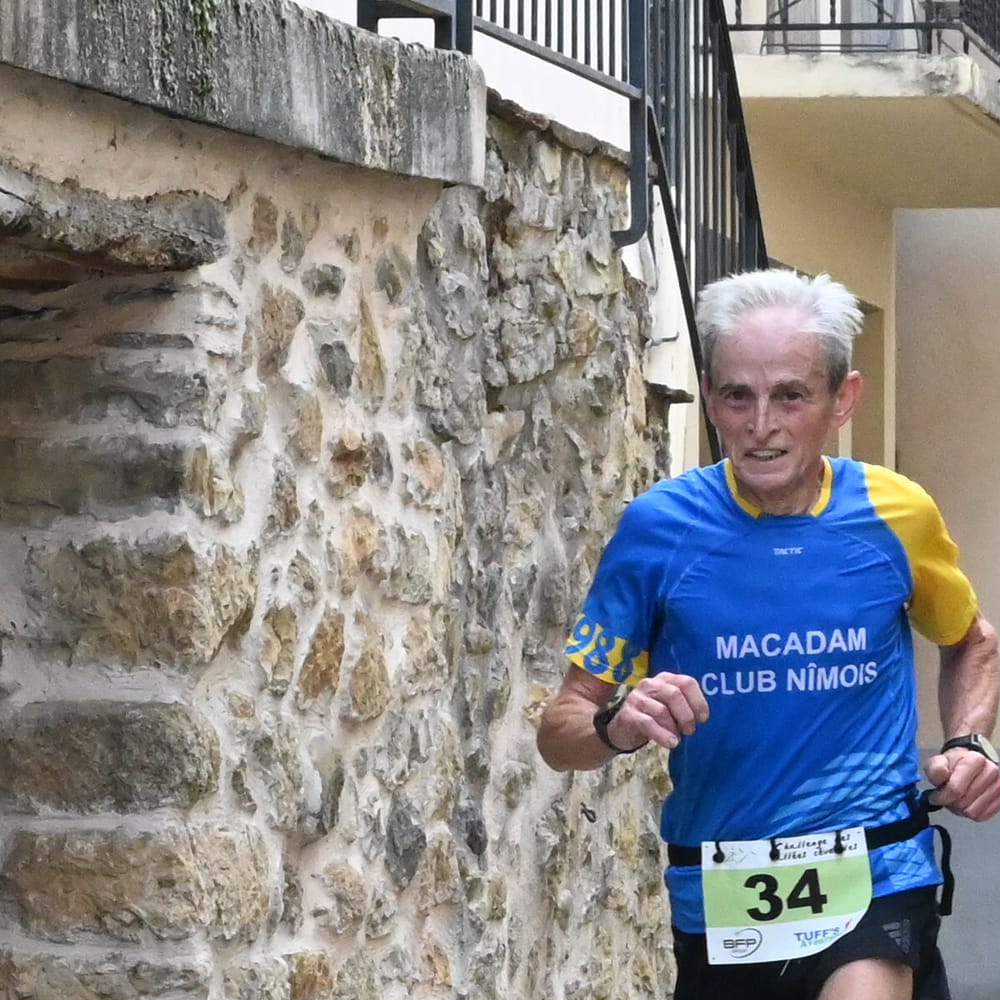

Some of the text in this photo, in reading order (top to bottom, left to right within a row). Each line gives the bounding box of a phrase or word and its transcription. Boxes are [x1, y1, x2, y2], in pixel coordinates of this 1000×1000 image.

[716, 626, 867, 660] MACADAM
[701, 660, 878, 696] CLUB NÎMOIS
[743, 867, 829, 923] 34
